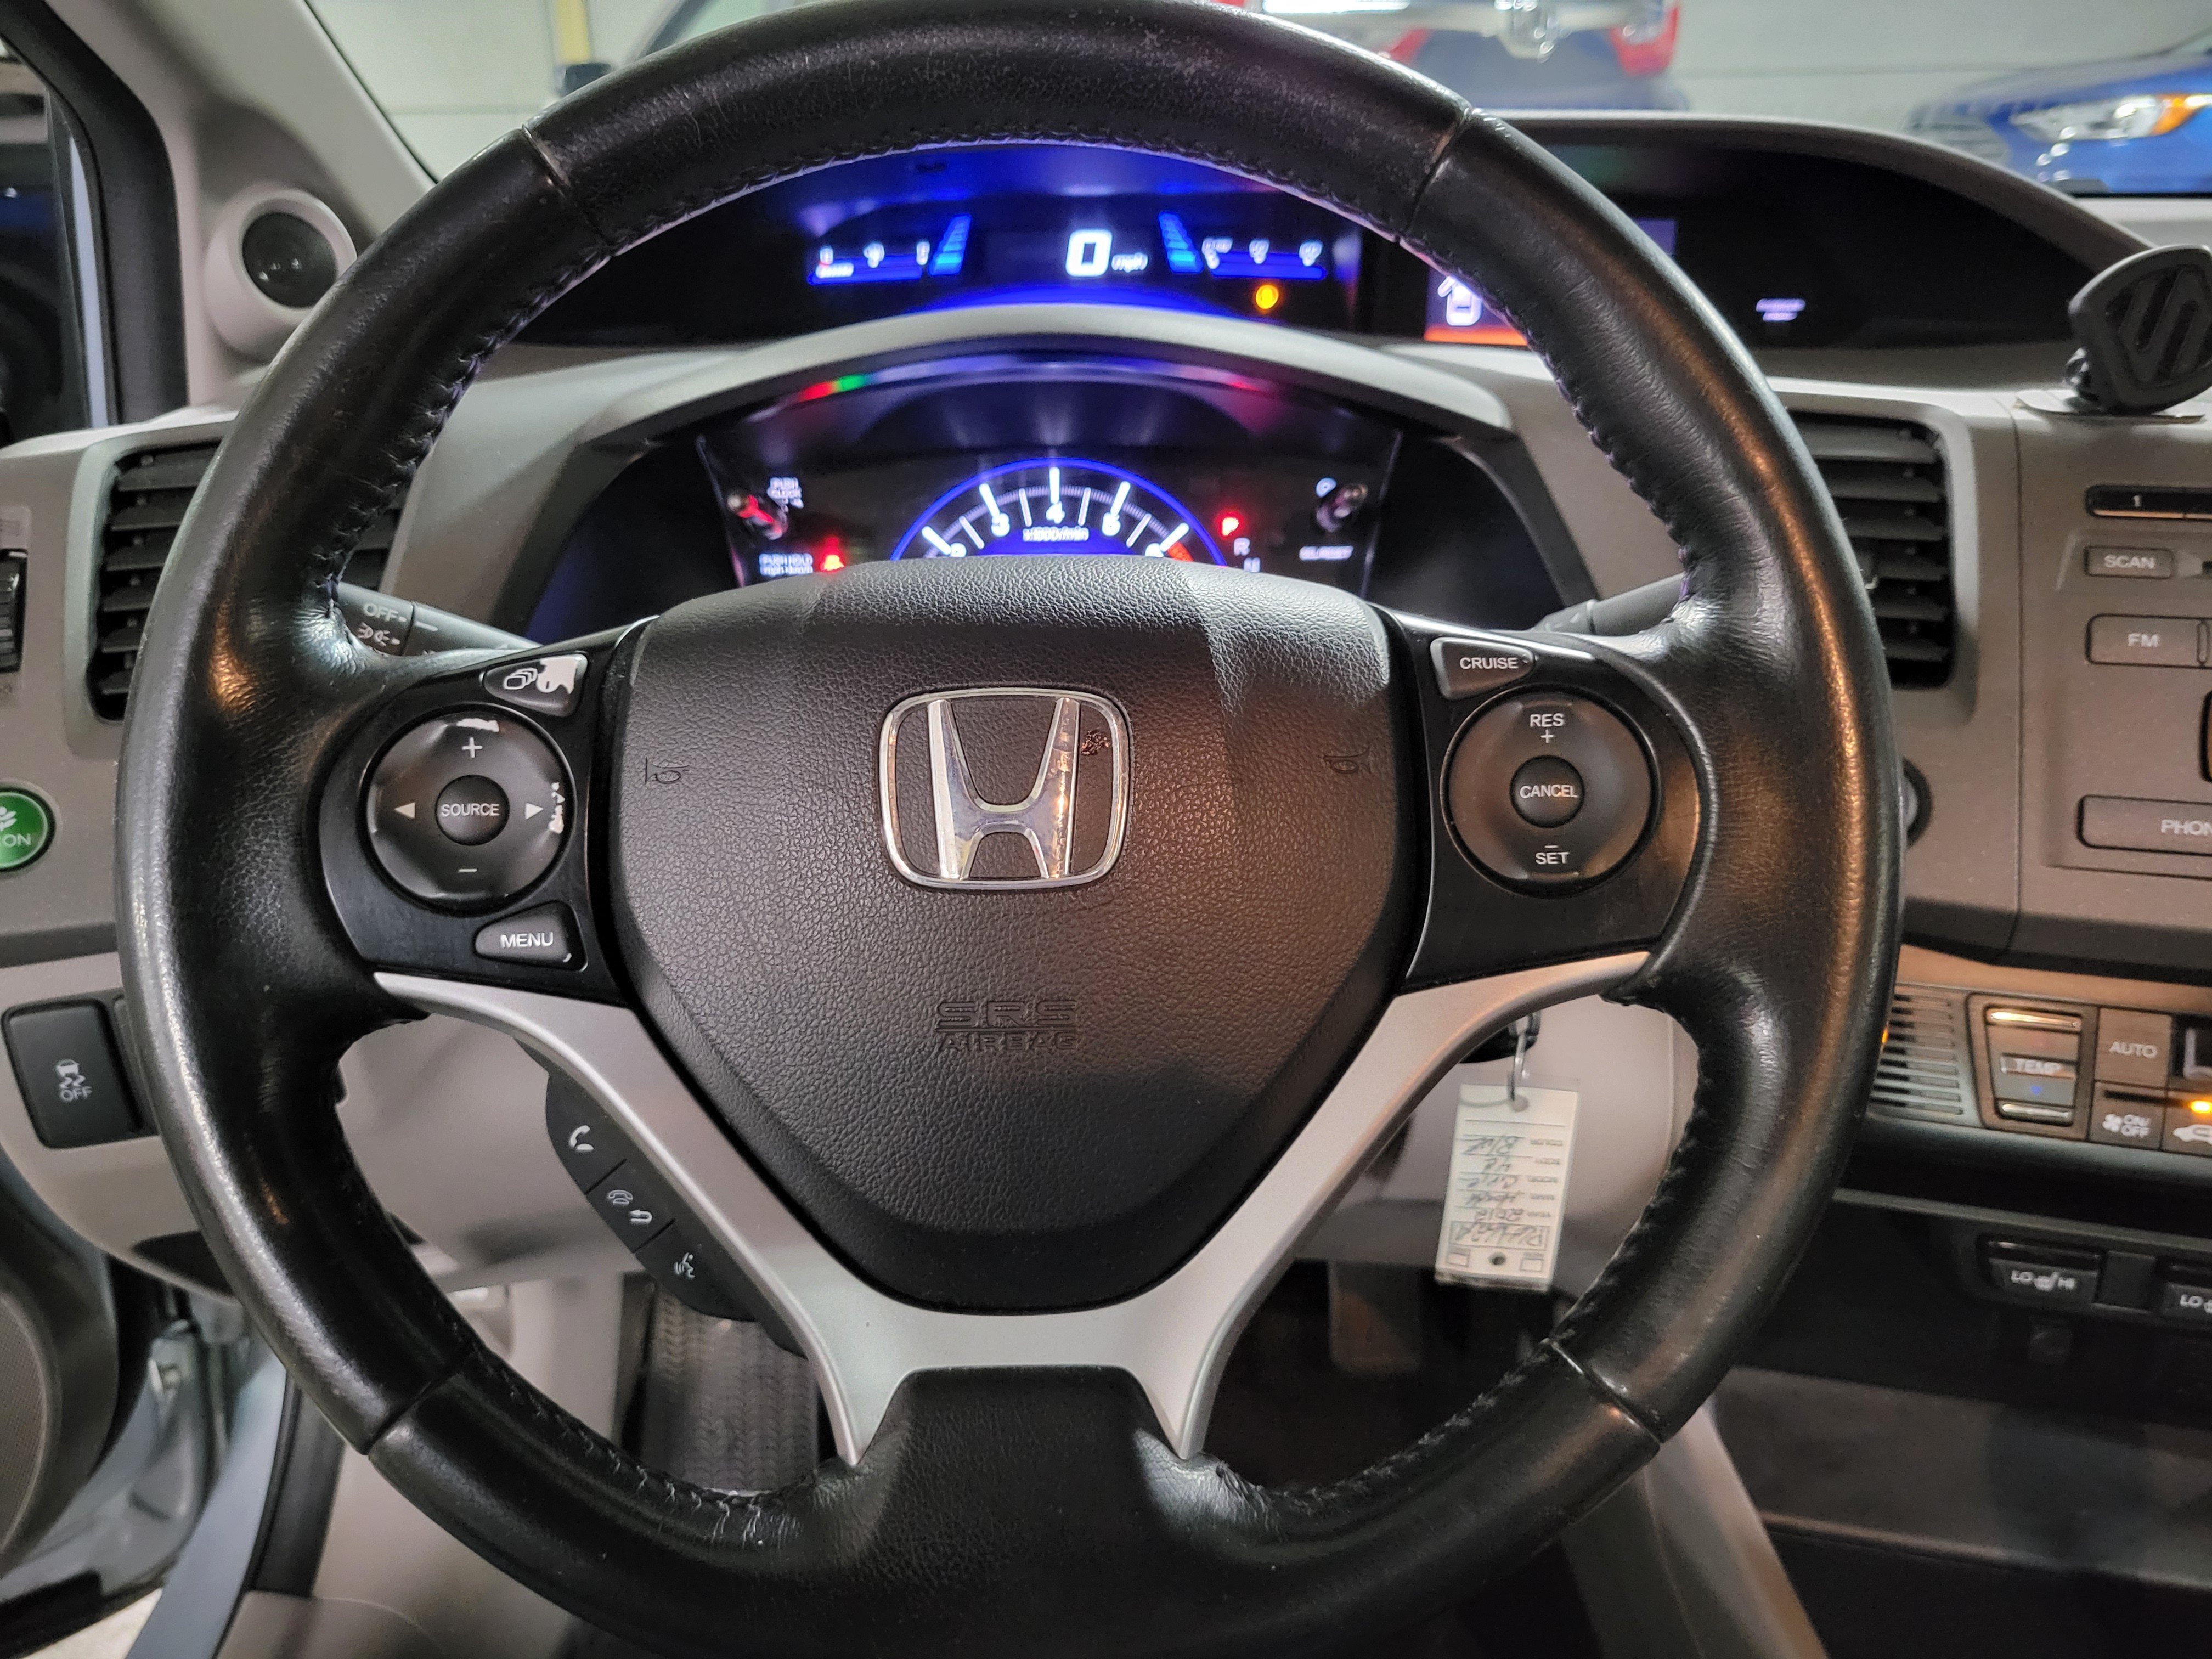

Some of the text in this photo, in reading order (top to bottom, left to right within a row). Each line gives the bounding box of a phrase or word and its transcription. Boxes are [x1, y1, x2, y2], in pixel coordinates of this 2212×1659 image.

[1065, 229, 1112, 276] 0
[1046, 501, 1065, 524] 4
[1234, 537, 1251, 556] R
[2103, 555, 2157, 570] SCAN
[363, 603, 399, 622] OFF
[2128, 633, 2160, 648] FM
[1459, 657, 1519, 670] CRUISE
[1530, 713, 1565, 728] RES
[1519, 785, 1579, 799] CANCEL
[441, 803, 500, 817] SOURCE
[1535, 851, 1570, 865] SET
[500, 932, 555, 948] MENU
[936, 1000, 1078, 1027] SRS
[938, 1031, 1080, 1052] AIRBAG
[2109, 1042, 2158, 1059] AUTO
[2014, 1058, 2062, 1075] TEMP
[60, 1085, 92, 1103] OFF
[2121, 1125, 2150, 1138] OFF
[2010, 1269, 2034, 1285] LO
[2180, 1294, 2204, 1308] LO
